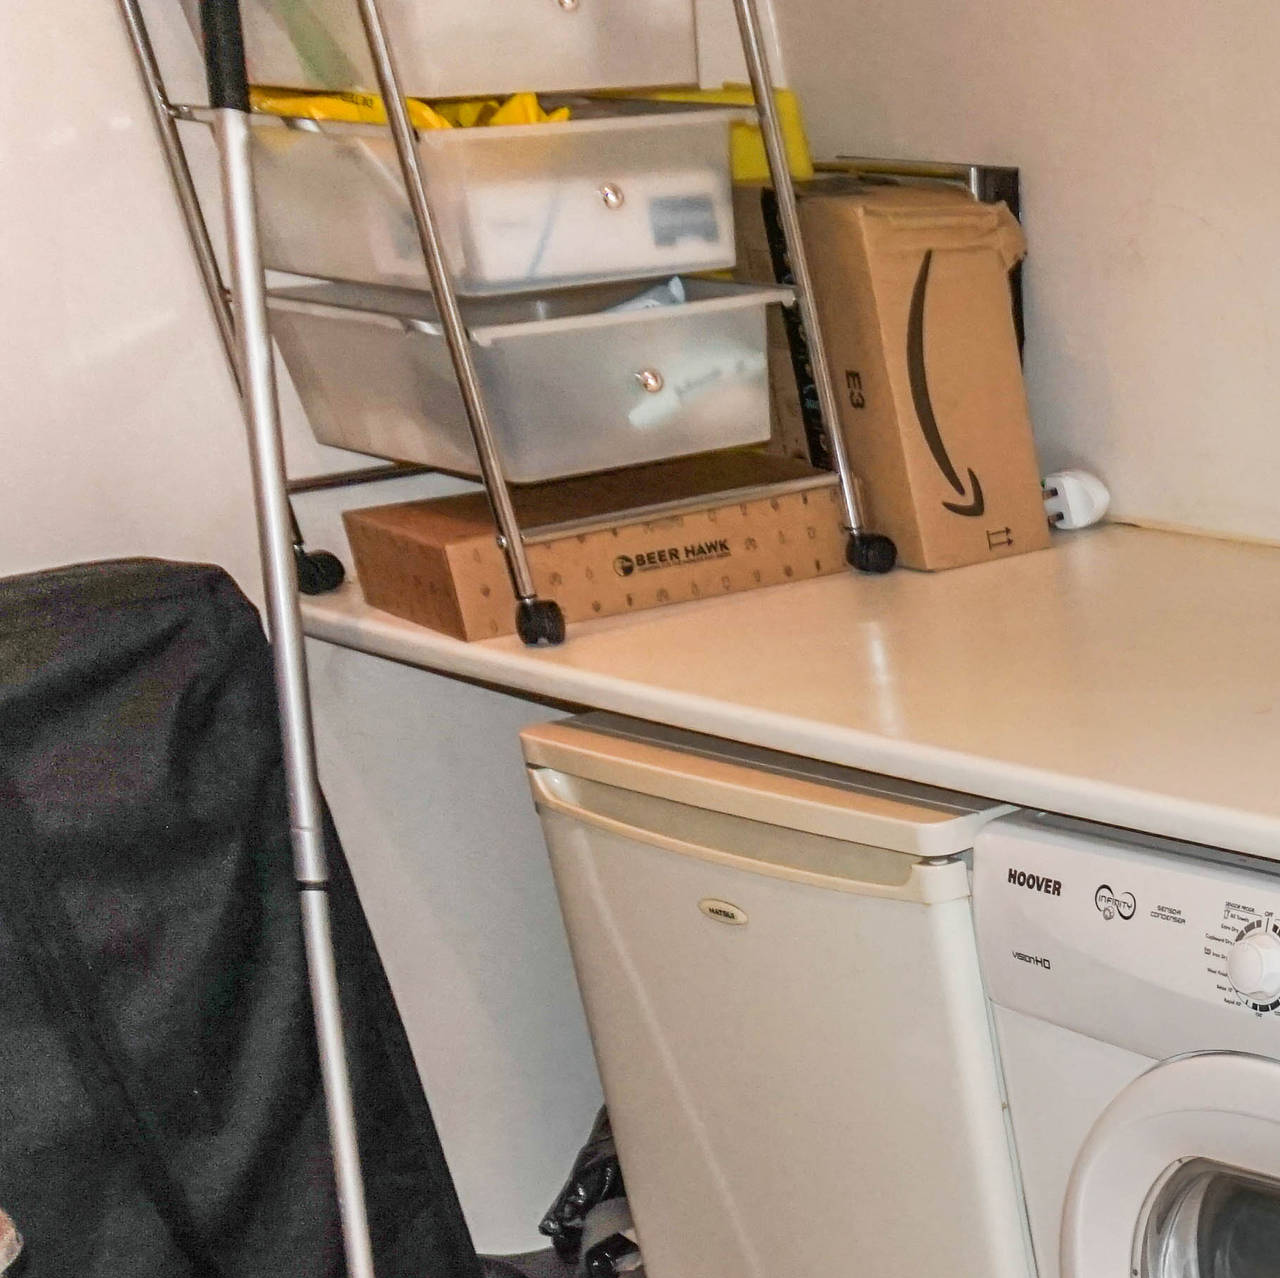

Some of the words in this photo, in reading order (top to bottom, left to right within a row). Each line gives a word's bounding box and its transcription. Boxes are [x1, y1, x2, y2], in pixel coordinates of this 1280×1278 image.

[845, 370, 865, 408] E3
[635, 548, 680, 567] BEER
[684, 538, 729, 558] HAWK
[1007, 868, 1062, 897] HOOVER
